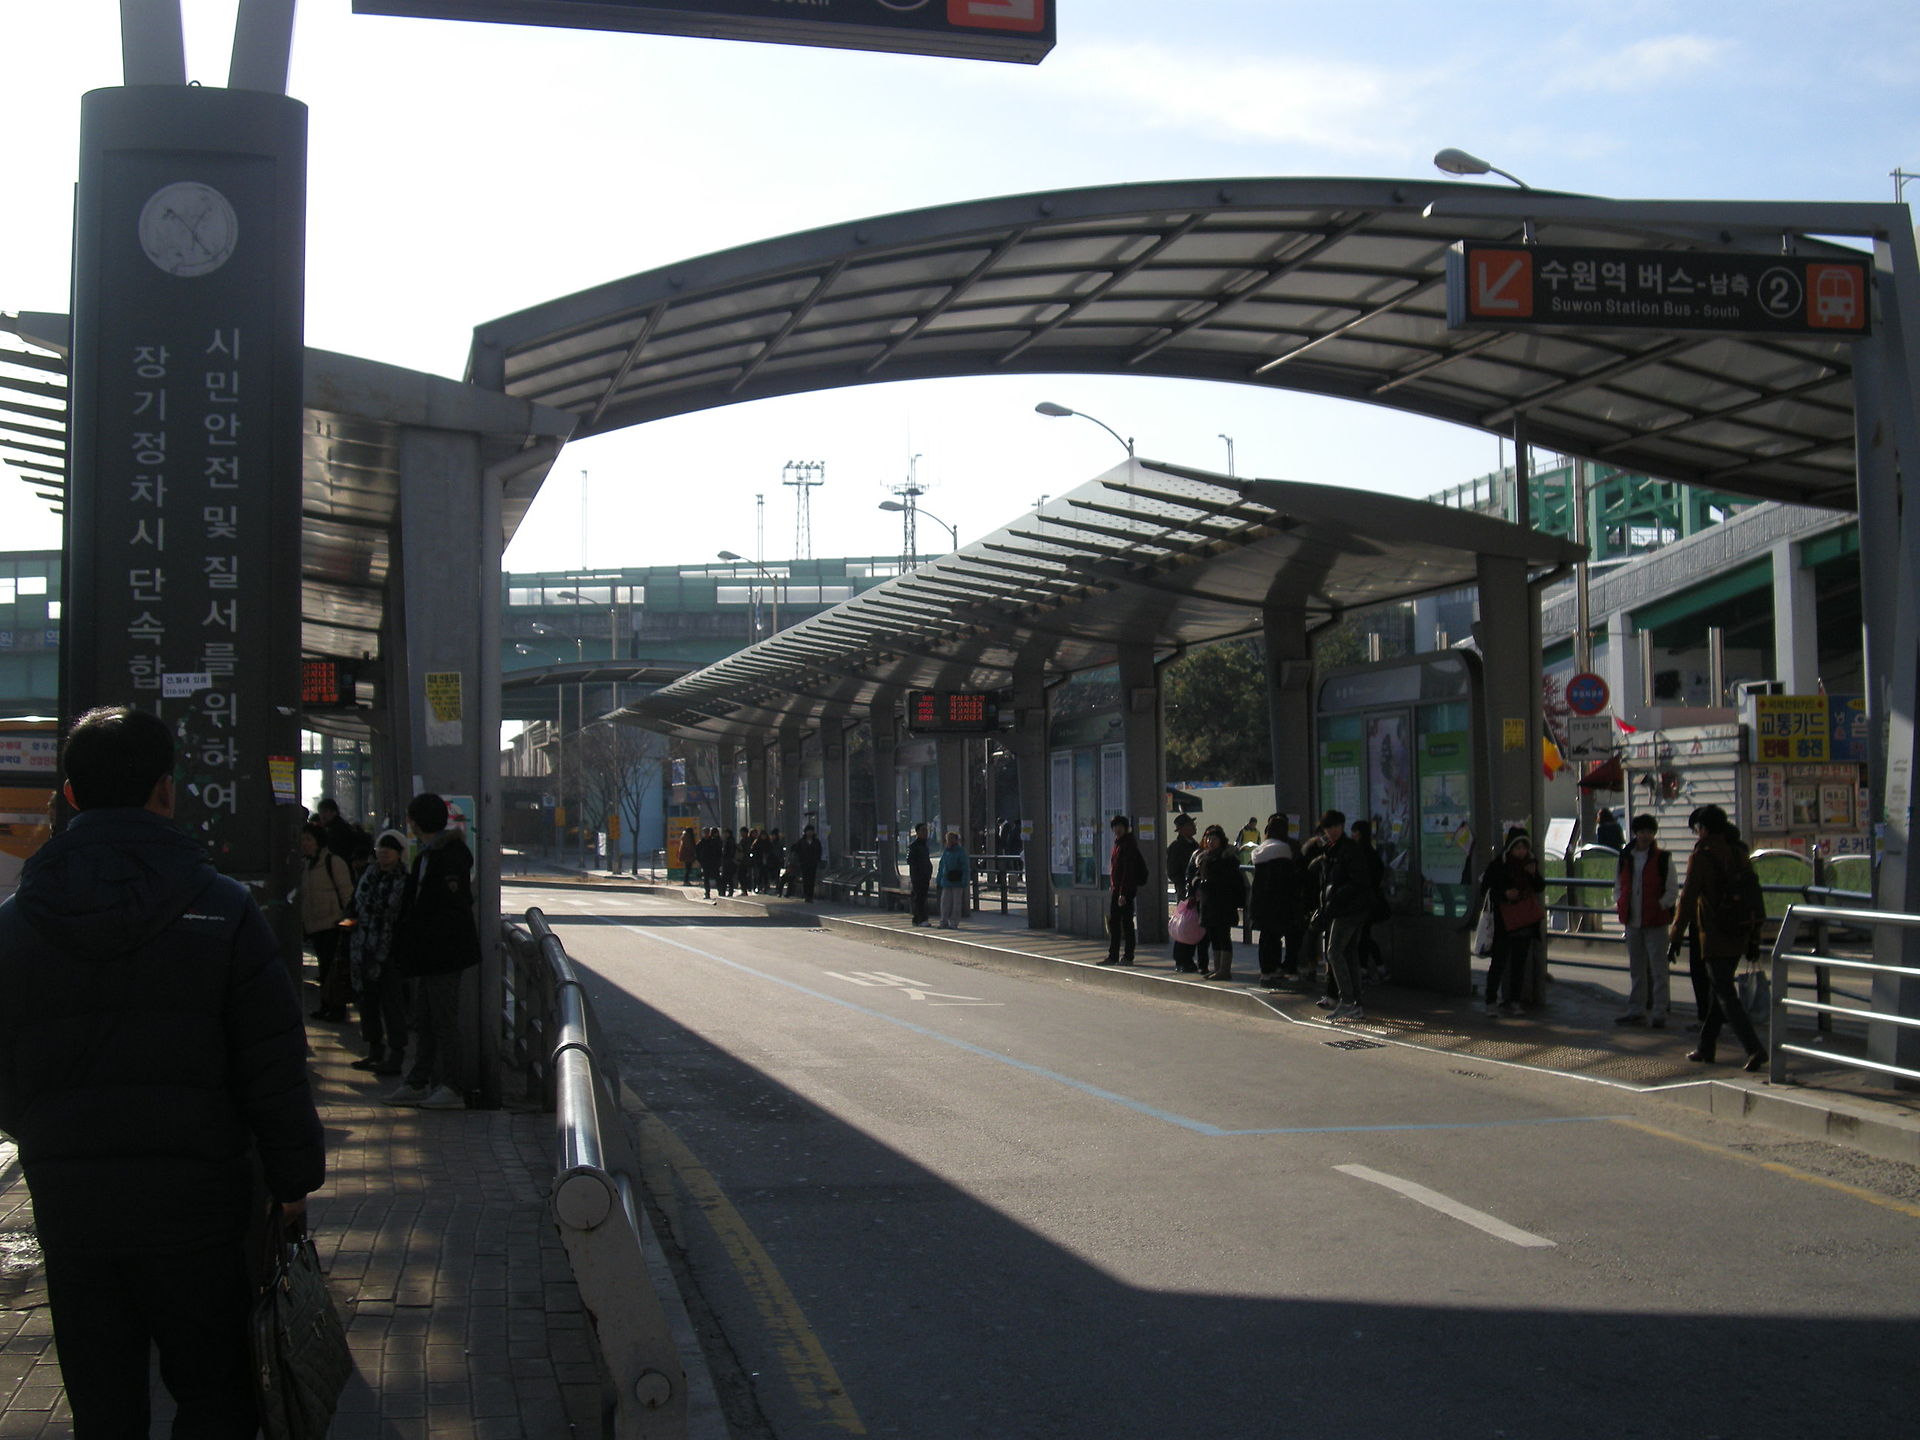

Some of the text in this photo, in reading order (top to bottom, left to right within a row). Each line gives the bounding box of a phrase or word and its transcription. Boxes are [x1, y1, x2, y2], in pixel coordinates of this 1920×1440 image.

[1540, 259, 1627, 293] 수원역
[1551, 297, 1601, 313] Suwon
[1605, 298, 1660, 316] Station
[1663, 300, 1691, 317] Bus
[1703, 304, 1740, 318] South
[1760, 711, 1825, 737] 교통카드
[1763, 738, 1790, 759] 판매
[1796, 738, 1824, 758] 충전
[1757, 766, 1772, 827] 교통카드
